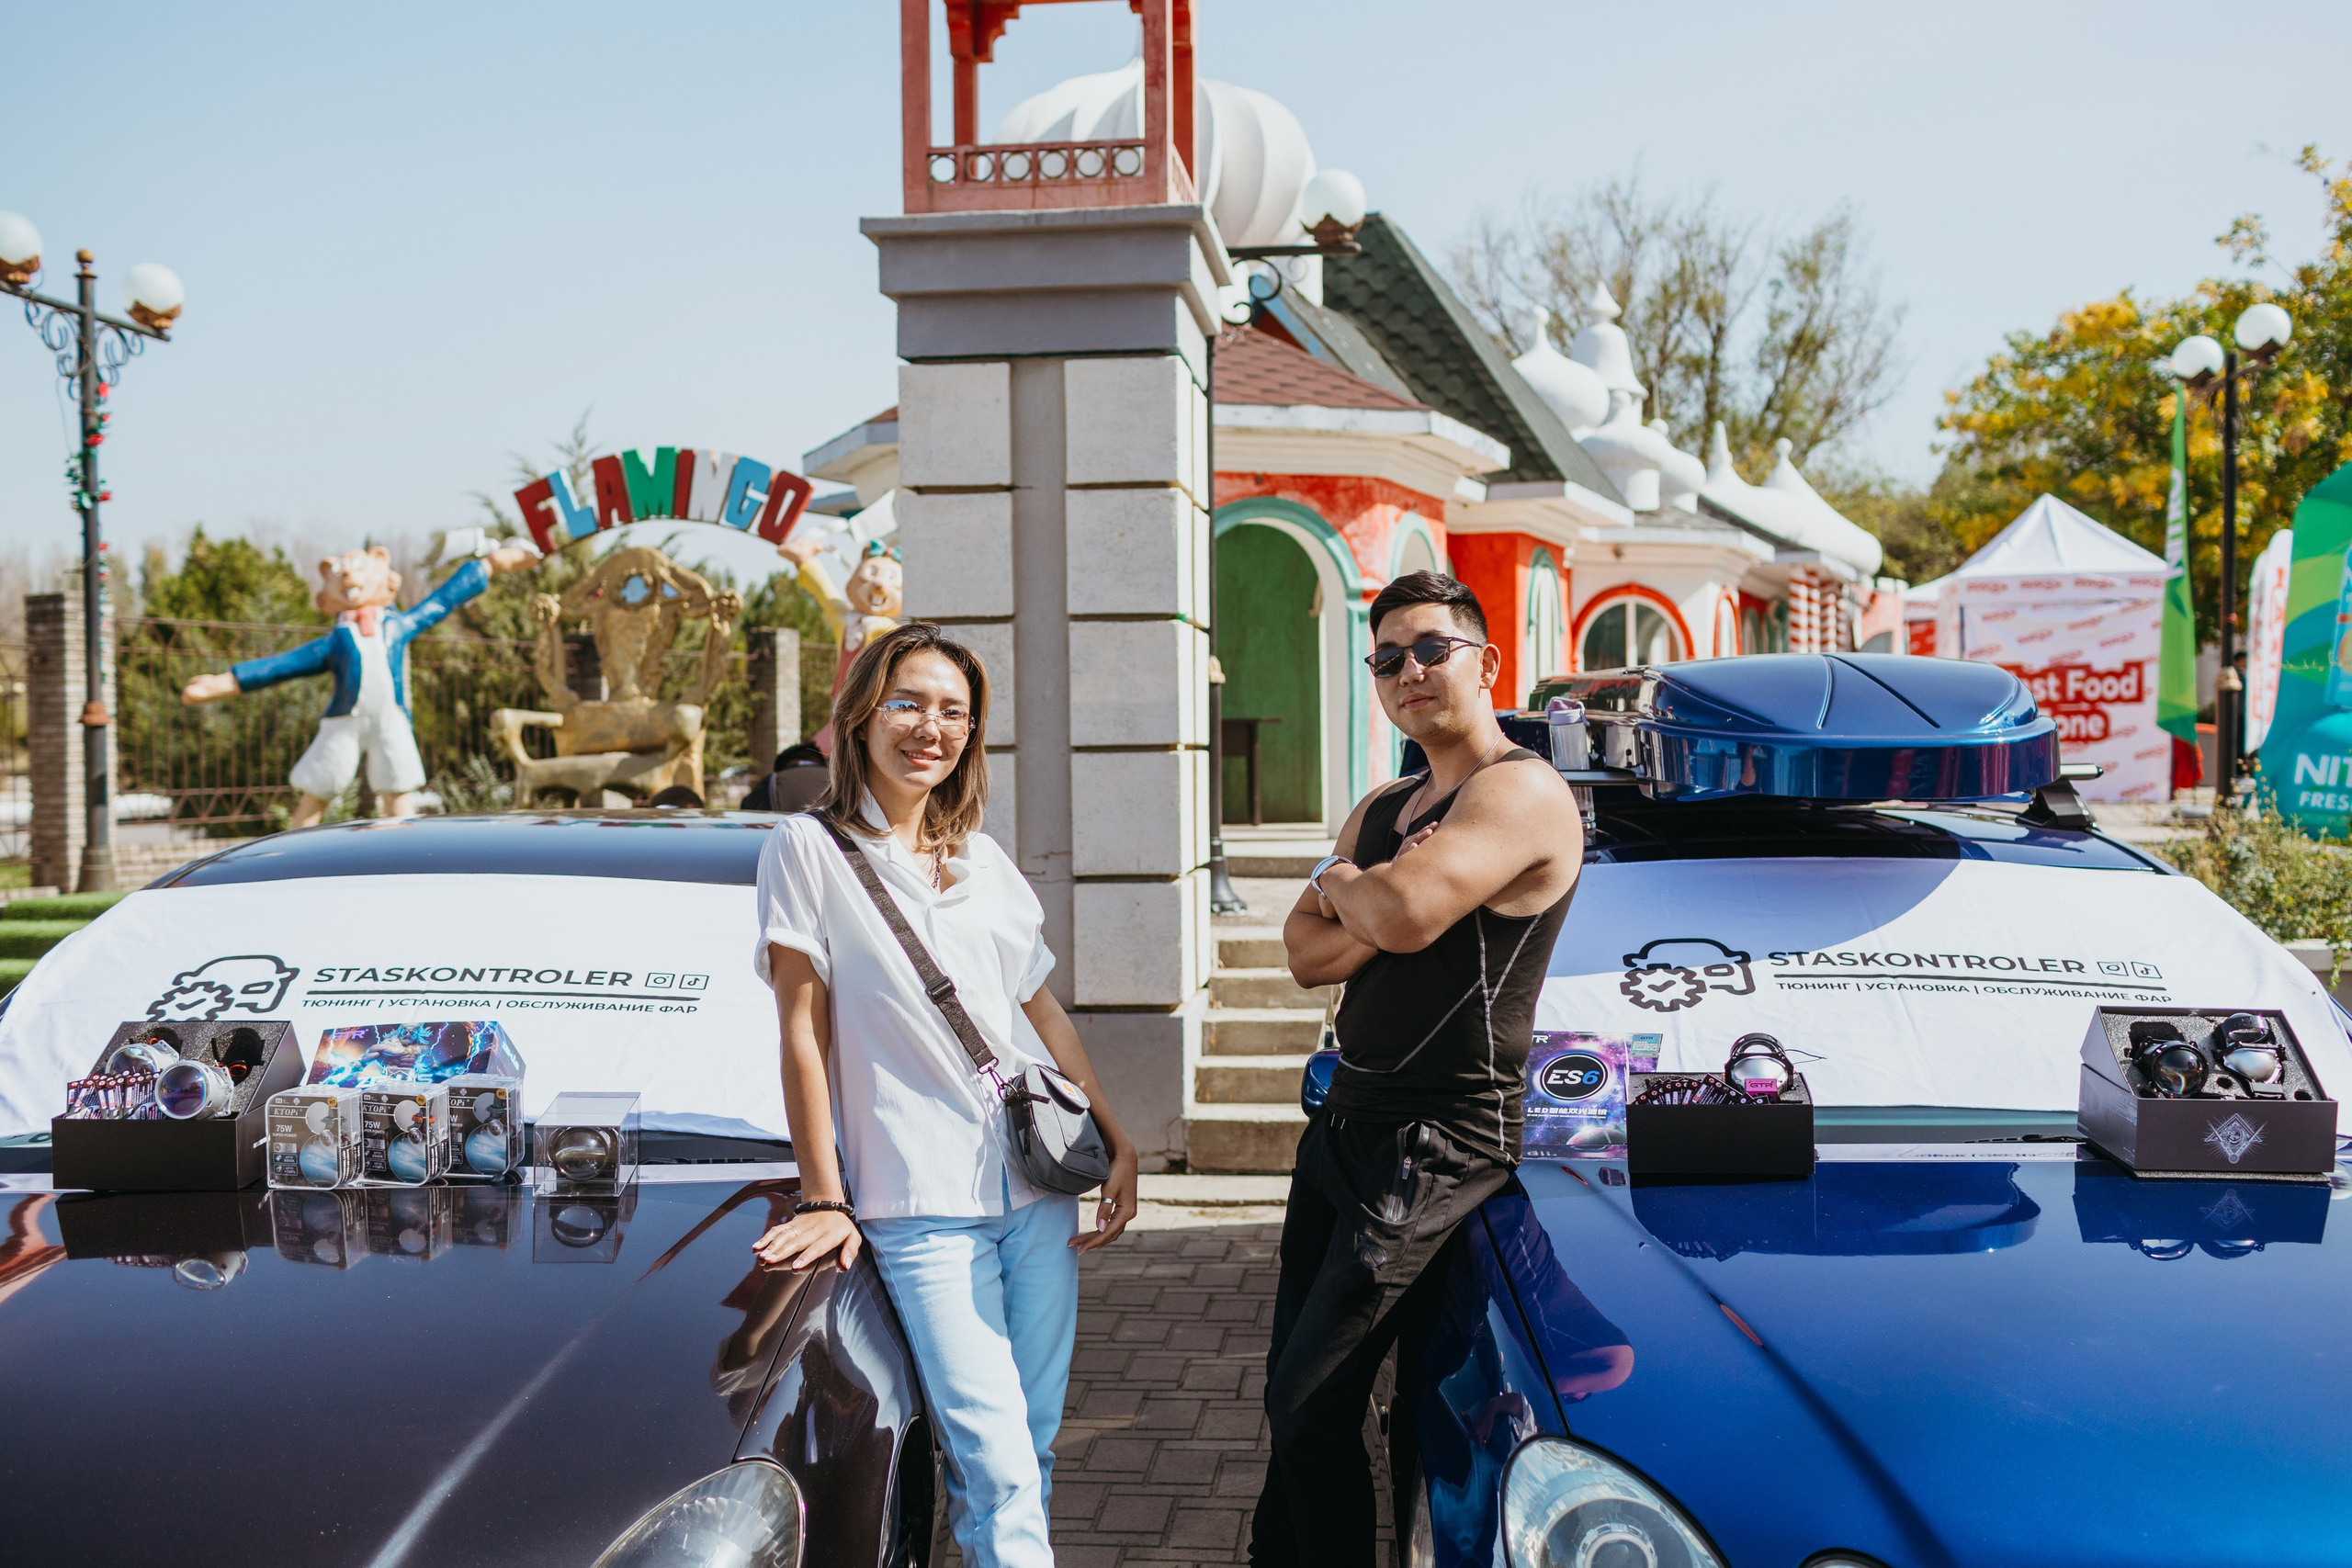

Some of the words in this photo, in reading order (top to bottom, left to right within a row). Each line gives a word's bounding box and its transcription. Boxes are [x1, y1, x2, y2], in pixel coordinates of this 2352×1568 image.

[514, 446, 814, 554] FLAMINGO
[2068, 666, 2139, 701] Food
[2054, 714, 2105, 739] one
[1768, 952, 2088, 974] STASKONTROLER
[313, 967, 633, 987] STASKONTROLER
[1776, 983, 1850, 991] ТЮНИНГ
[1864, 983, 1970, 992] УСТАНОВКА
[1984, 986, 2132, 1000] ОБСЛУЖИВАНИЕ
[2134, 994, 2172, 1003] ФАР
[302, 998, 376, 1008] ТЮНИНГ
[388, 998, 492, 1008] УСТАНОВКА
[506, 1000, 655, 1012] ОБСЛУЖИВАНИЕ
[659, 1005, 697, 1013] ФАР
[329, 1030, 366, 1041] GTR
[1532, 1034, 1550, 1043] TR
[1547, 1069, 1600, 1085] ES6
[276, 1124, 292, 1133] 75W
[365, 1121, 381, 1129] 75W
